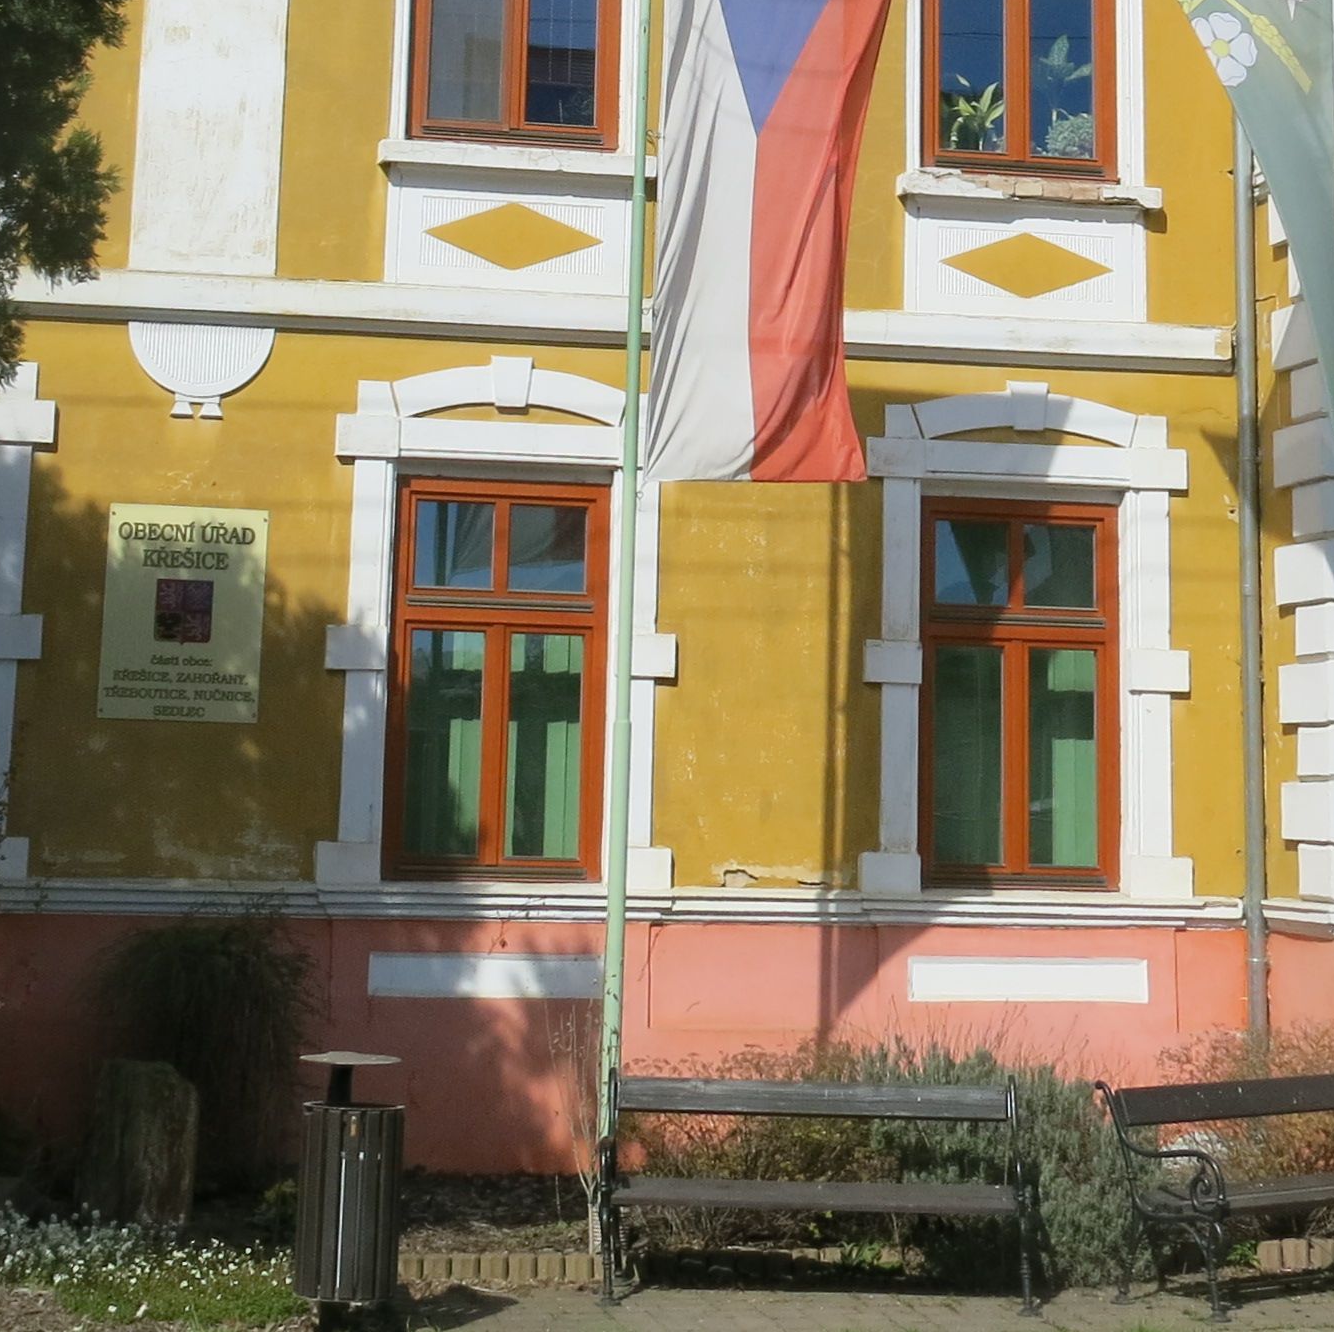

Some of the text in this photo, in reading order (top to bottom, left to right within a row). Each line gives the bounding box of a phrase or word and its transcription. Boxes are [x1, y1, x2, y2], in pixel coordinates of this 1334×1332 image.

[118, 521, 256, 545] OBECNÍ ÚŘAD
[142, 546, 230, 570] KŘEŠICE
[152, 705, 206, 718] SEDLEC
